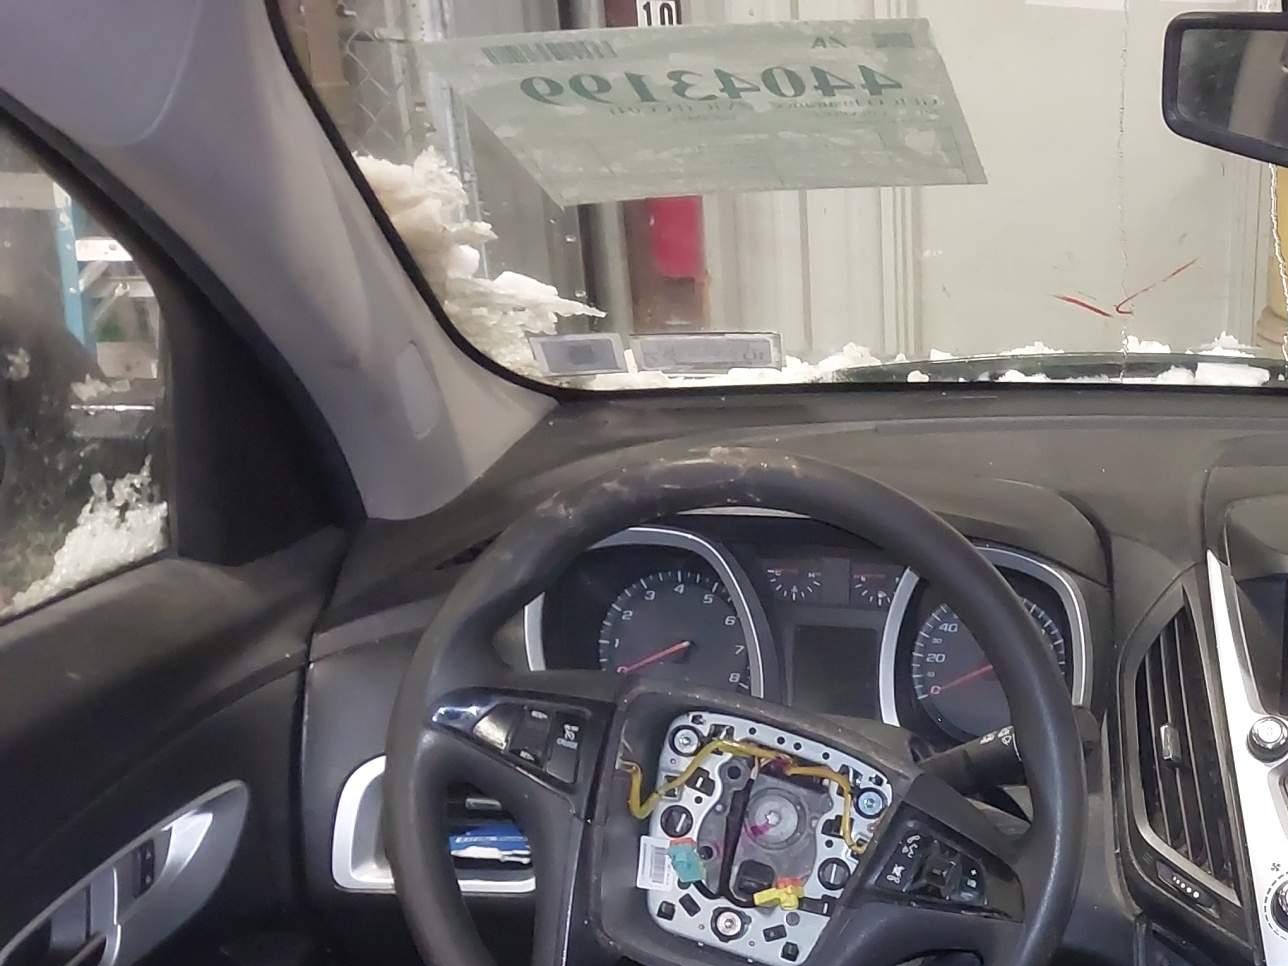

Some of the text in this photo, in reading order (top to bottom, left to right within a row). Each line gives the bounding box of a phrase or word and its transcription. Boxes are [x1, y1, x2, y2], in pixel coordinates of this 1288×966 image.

[673, 583, 685, 594] 4
[644, 590, 656, 601] 3
[703, 593, 715, 604] 5
[621, 610, 633, 620] 2
[724, 615, 736, 626] 6
[938, 623, 959, 633] 40
[614, 638, 620, 648] 1
[735, 645, 745, 655] 7
[926, 653, 946, 663] 20
[729, 672, 741, 683] 8
